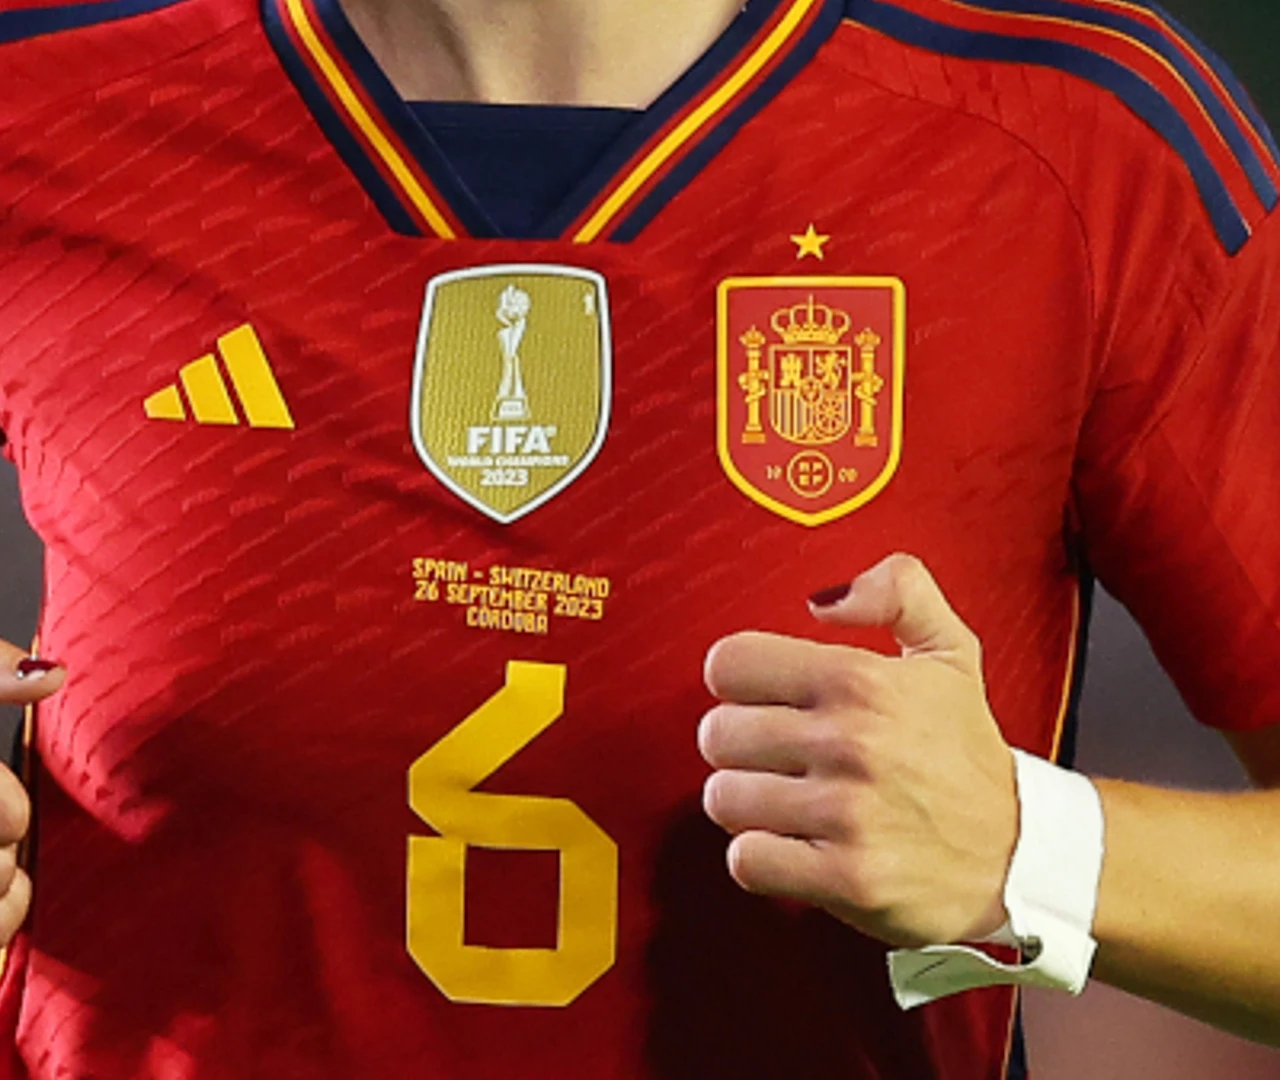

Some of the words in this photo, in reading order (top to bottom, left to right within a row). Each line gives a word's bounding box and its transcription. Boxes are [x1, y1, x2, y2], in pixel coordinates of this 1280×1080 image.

[480, 469, 529, 486] 2023
[412, 557, 468, 582] SPAIN
[489, 565, 610, 599] SWITZERLAND
[414, 580, 439, 601] 26
[446, 583, 549, 612] SEPTEMBER
[553, 595, 604, 620] 2023
[406, 660, 618, 1007] 6
